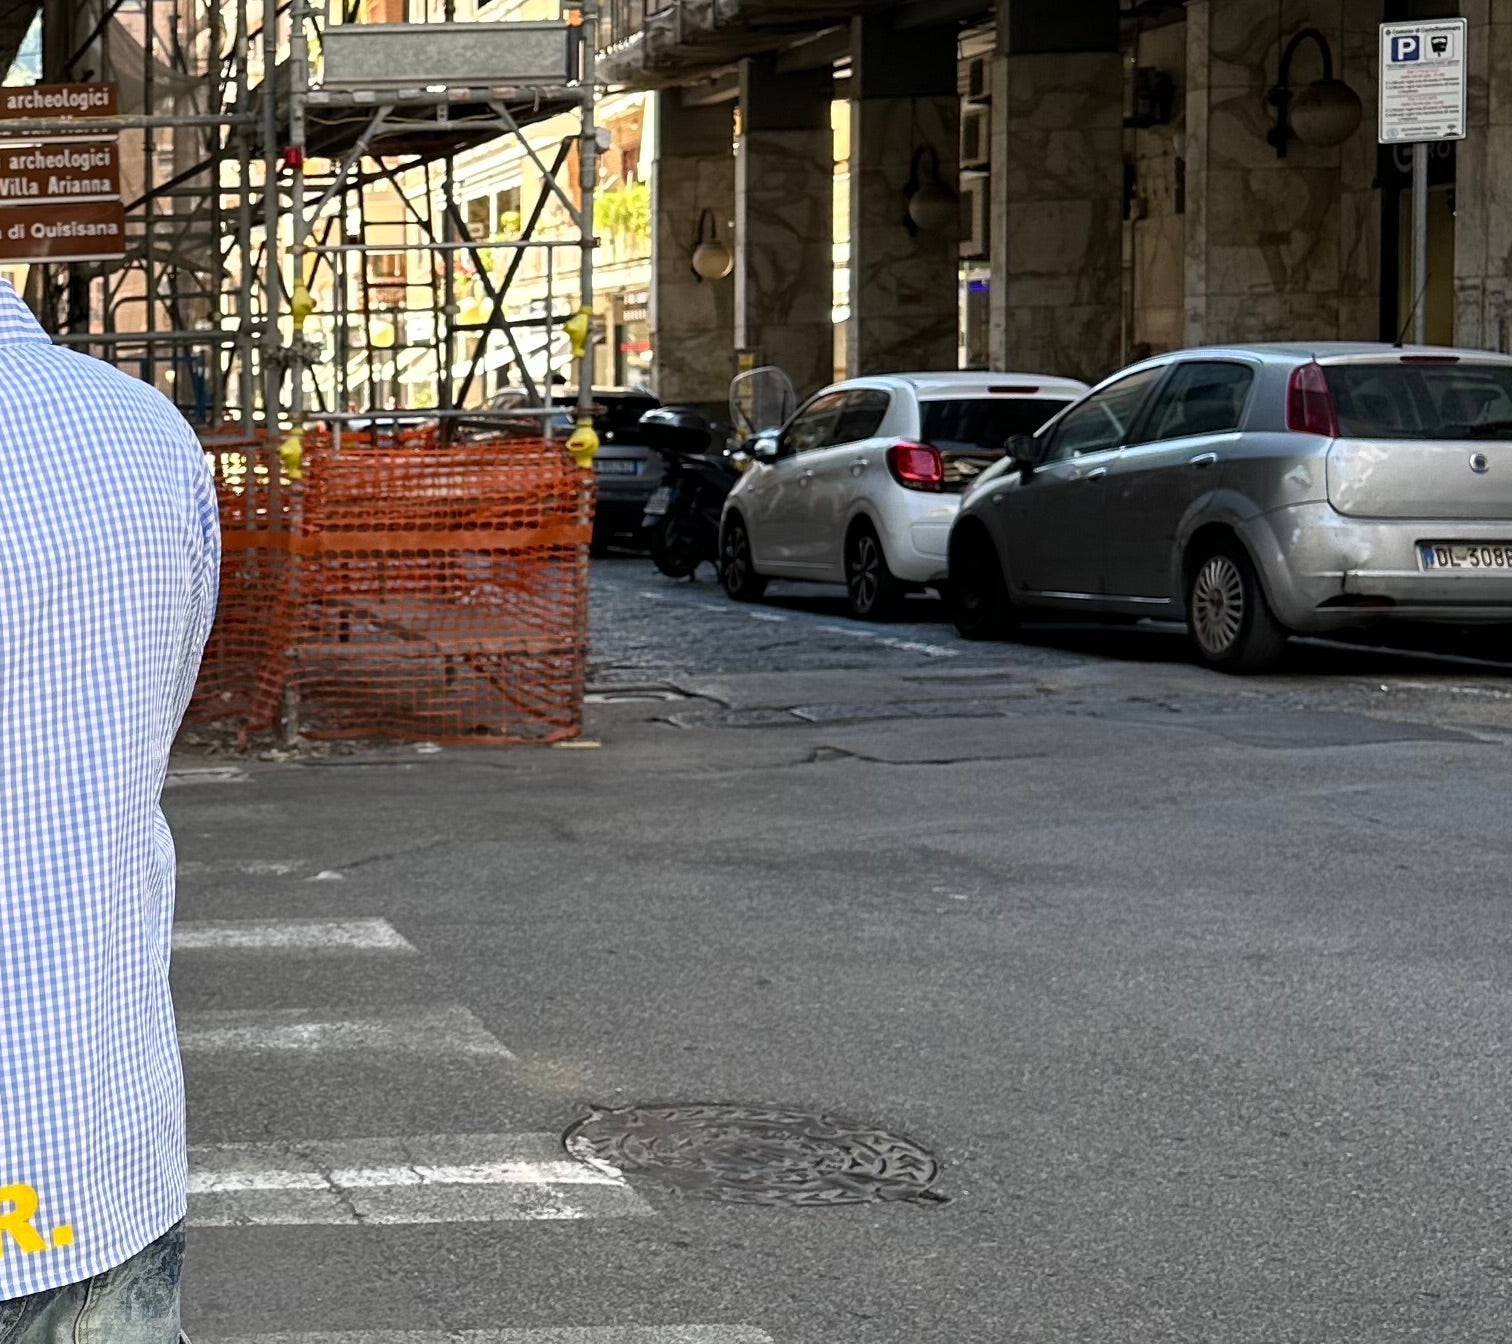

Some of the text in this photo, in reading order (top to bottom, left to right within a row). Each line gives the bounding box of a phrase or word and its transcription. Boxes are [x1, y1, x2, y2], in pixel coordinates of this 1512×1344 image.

[1397, 37, 1417, 60] P
[7, 88, 109, 111] archeologici
[8, 149, 111, 172] archeologici
[48, 175, 112, 195] Arianna
[8, 222, 26, 240] di
[30, 220, 119, 240] Quisisana
